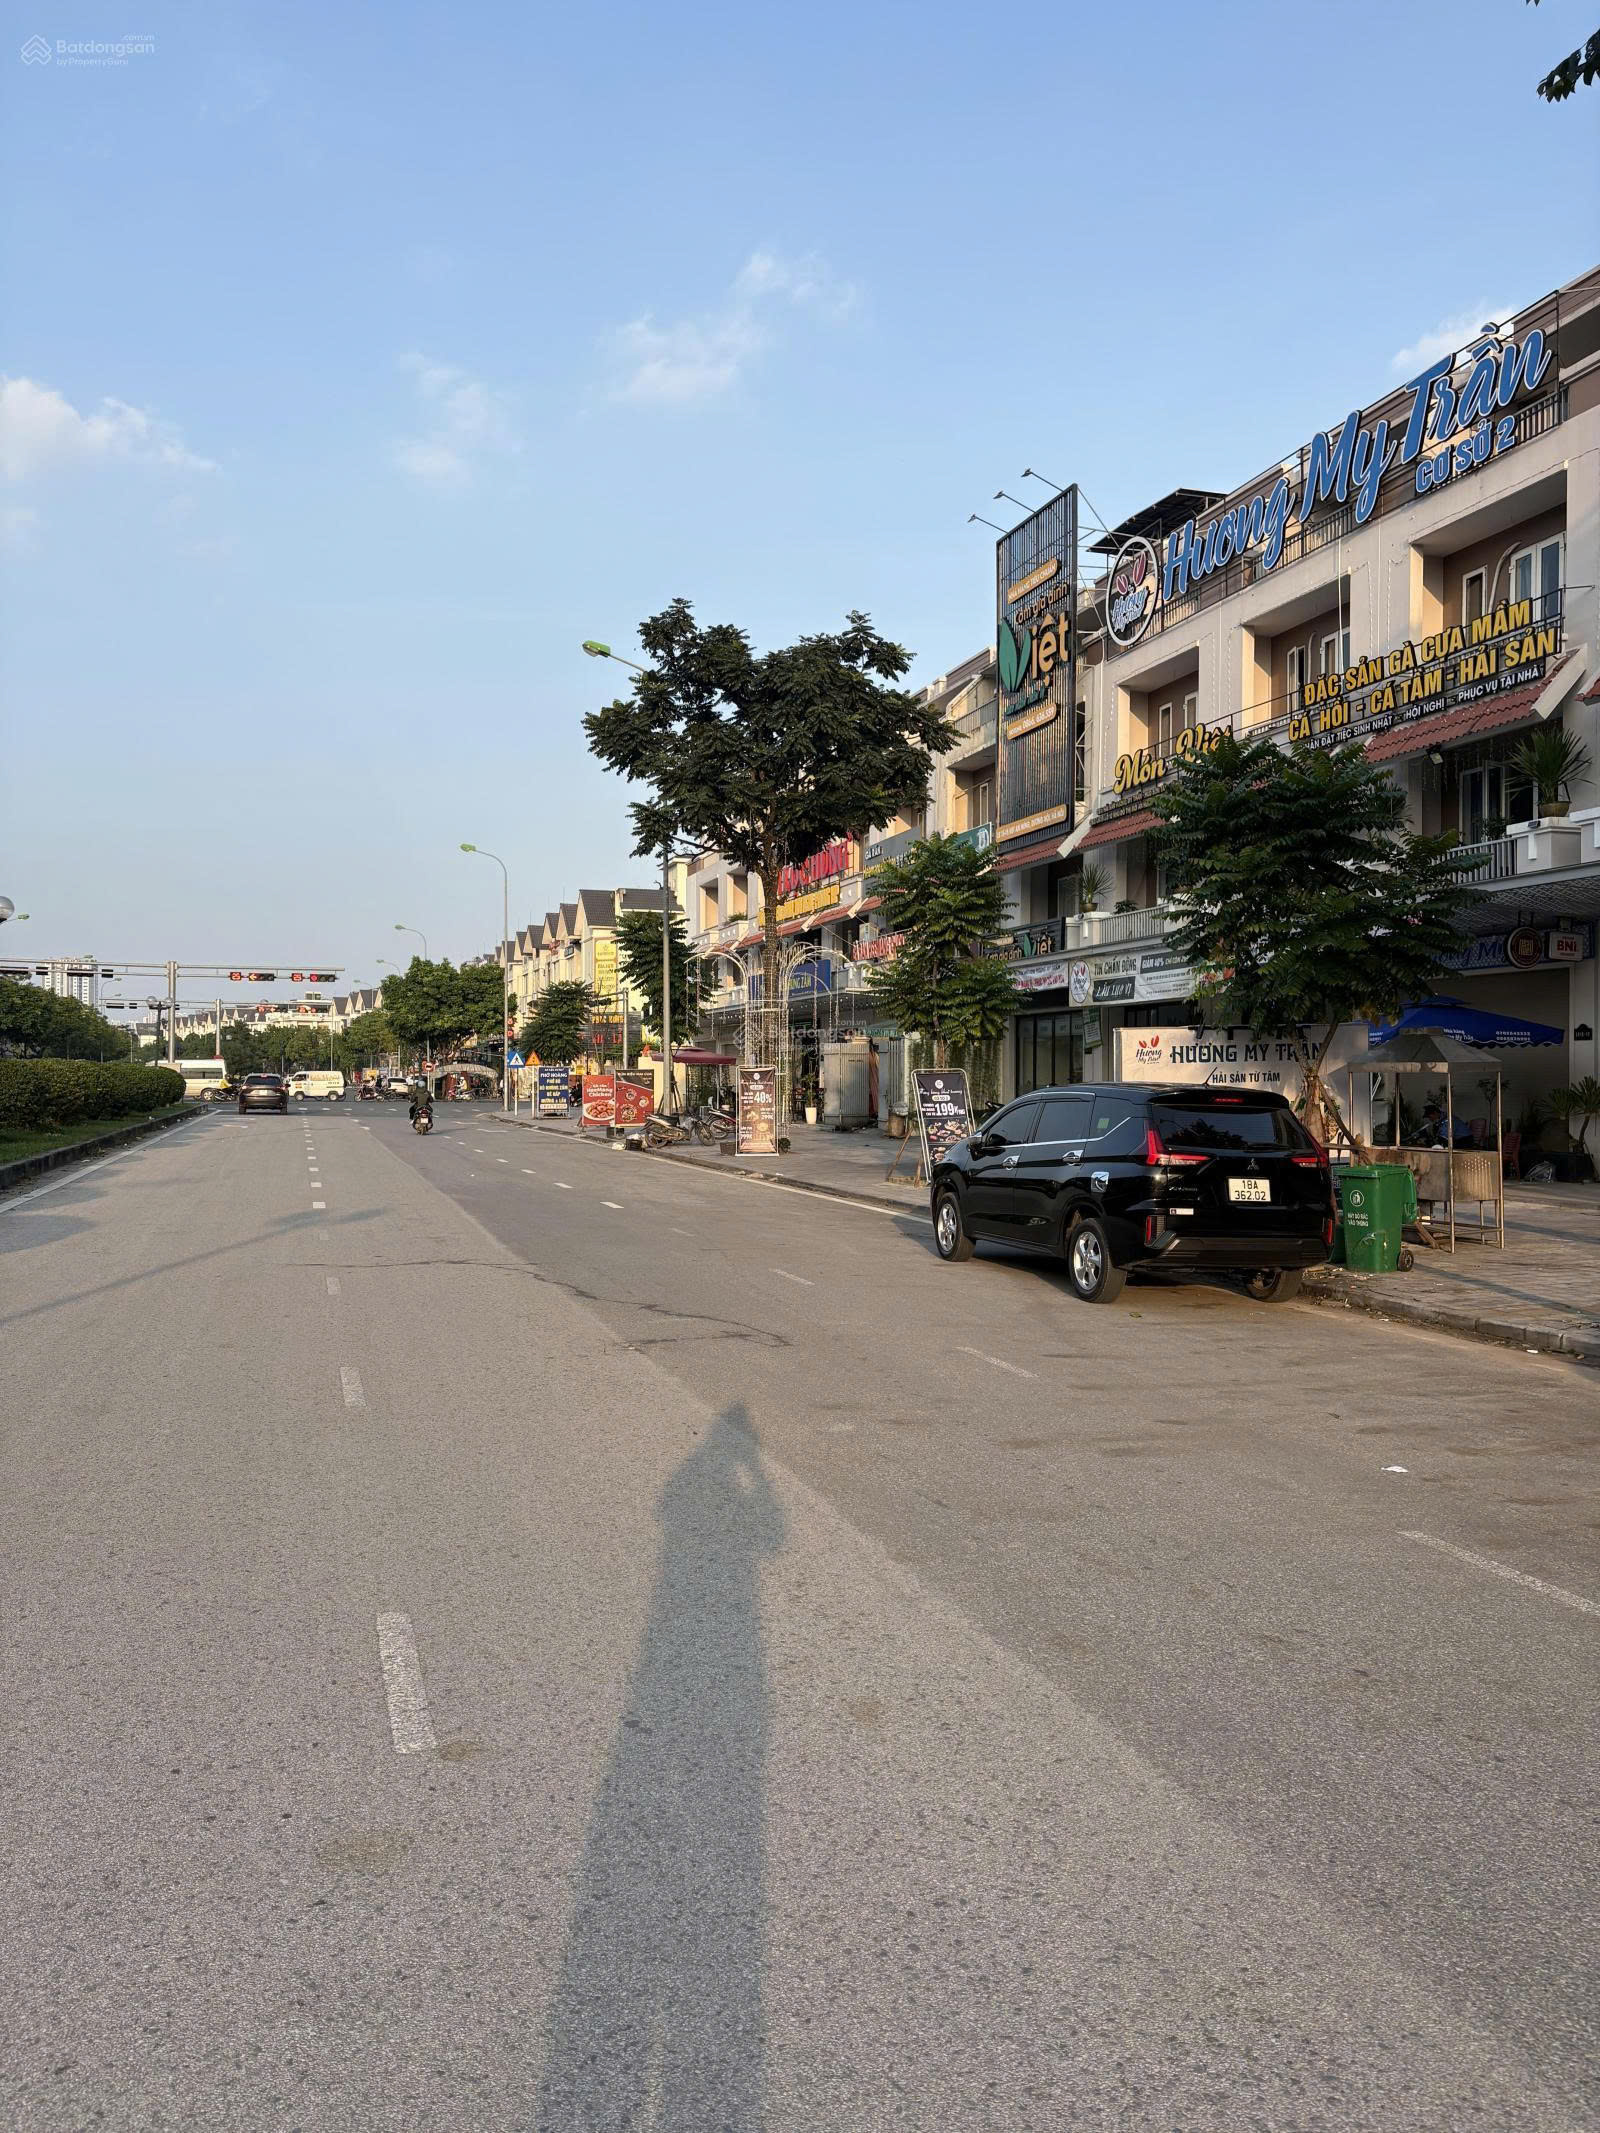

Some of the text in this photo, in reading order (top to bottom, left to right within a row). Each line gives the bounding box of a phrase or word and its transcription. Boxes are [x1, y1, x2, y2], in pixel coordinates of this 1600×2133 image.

[1163, 322, 1552, 601] Hương My Trần
[1415, 414, 1517, 494] CƠ SỞ 2
[1304, 599, 1533, 706] ĐẶC SẢN GÀ CỰA MẦM
[1289, 712, 1311, 742] CÁ
[1320, 697, 1350, 734] HỒI
[1370, 681, 1397, 714] CÁ
[1401, 667, 1443, 705] TẦM
[1460, 645, 1497, 685] HẢI
[1505, 627, 1556, 667] SẢN
[1458, 664, 1539, 702] PHỤC VỤ TẠI NHÀ
[1406, 699, 1445, 720] HỘI NGHỊ
[1321, 734, 1335, 747] ĐẶT
[1337, 729, 1351, 742] TIỆC
[1354, 723, 1371, 736] SINH
[1372, 715, 1393, 730] NHẬT
[1113, 749, 1167, 795] Món
[1170, 1042, 1237, 1064] HƯƠNG
[1243, 1043, 1269, 1062] MY
[1212, 1069, 1280, 1083] HẢI SẢN TỪ TÂM
[754, 1091, 773, 1104] 40%
[1235, 1190, 1267, 1200] 362.02
[1242, 1180, 1259, 1190] 18A
